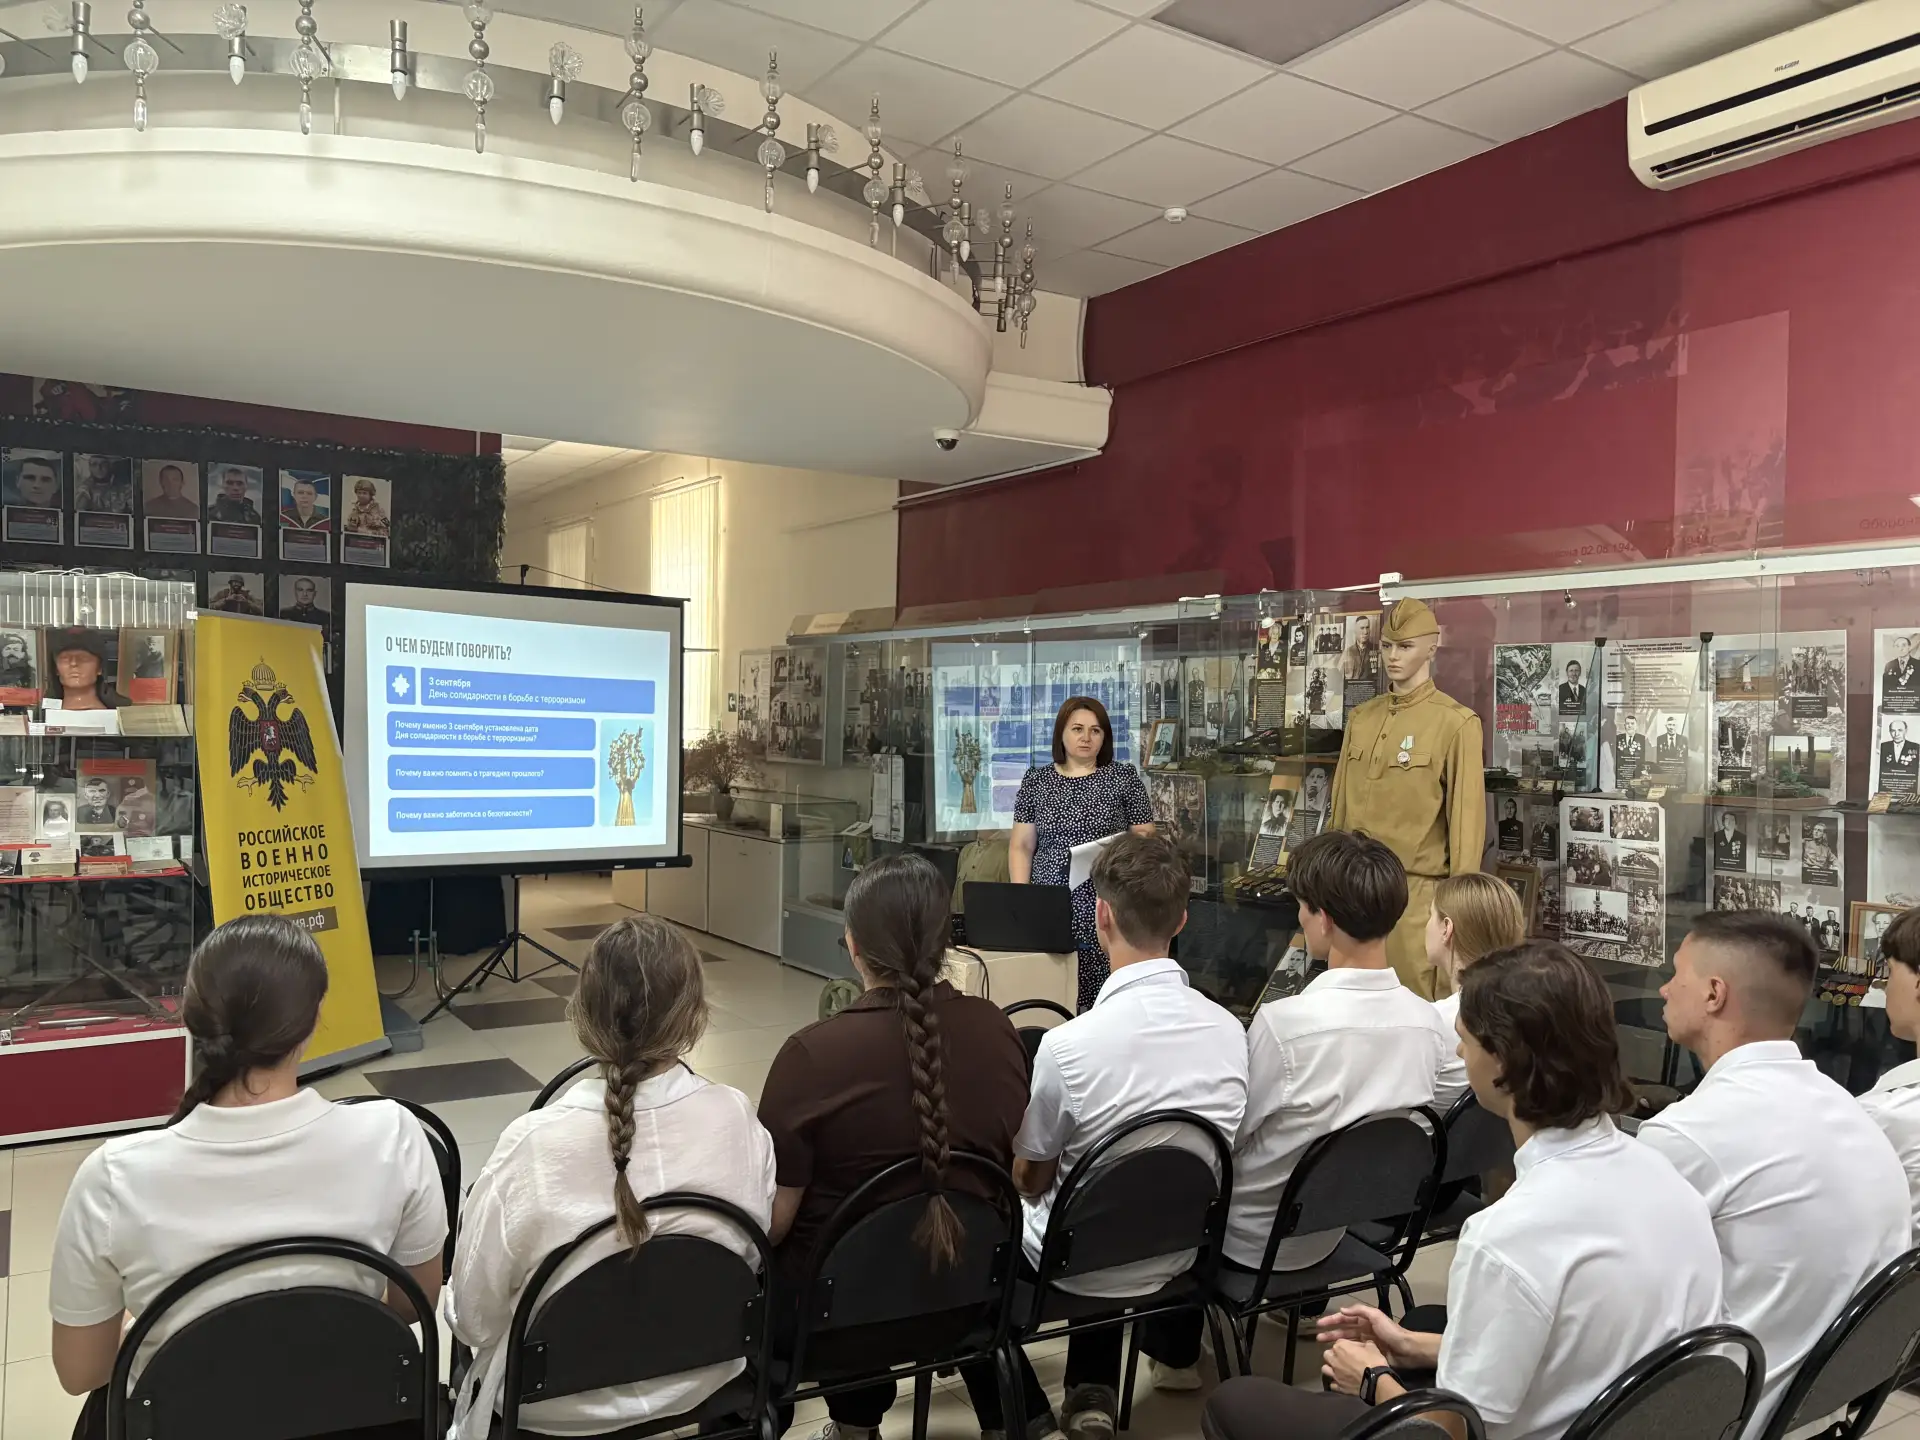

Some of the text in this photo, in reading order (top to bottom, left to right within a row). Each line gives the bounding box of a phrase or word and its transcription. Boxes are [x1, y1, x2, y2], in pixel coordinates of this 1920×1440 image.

[386, 636, 512, 660] О ЧЕМ БУДЕМ ГОВОРИТЬ?
[428, 676, 471, 689] 3 сентября
[428, 689, 448, 699] День
[449, 691, 500, 702] солидарности
[508, 694, 534, 703] борьбе
[541, 696, 586, 705] терроризмом
[395, 720, 539, 734] Почему именно 3 сентября установлена дата
[395, 731, 409, 740] Дня
[410, 732, 457, 741] солидарности
[463, 733, 486, 742] борьбе
[492, 734, 537, 743] терроризмом?
[395, 768, 422, 778] Почему
[479, 769, 510, 778] трагедиях
[511, 769, 545, 778] прошлого?
[396, 811, 422, 820] Почему
[487, 809, 533, 818] безопасности?
[238, 824, 326, 847] РОССИЙСКОЕ
[240, 843, 329, 870] ВОЕННО
[242, 864, 331, 889] ИСТОРИЧЕСКОЕ
[245, 882, 334, 911] ОБЩЕСТВО
[292, 911, 325, 930] ия.рф
